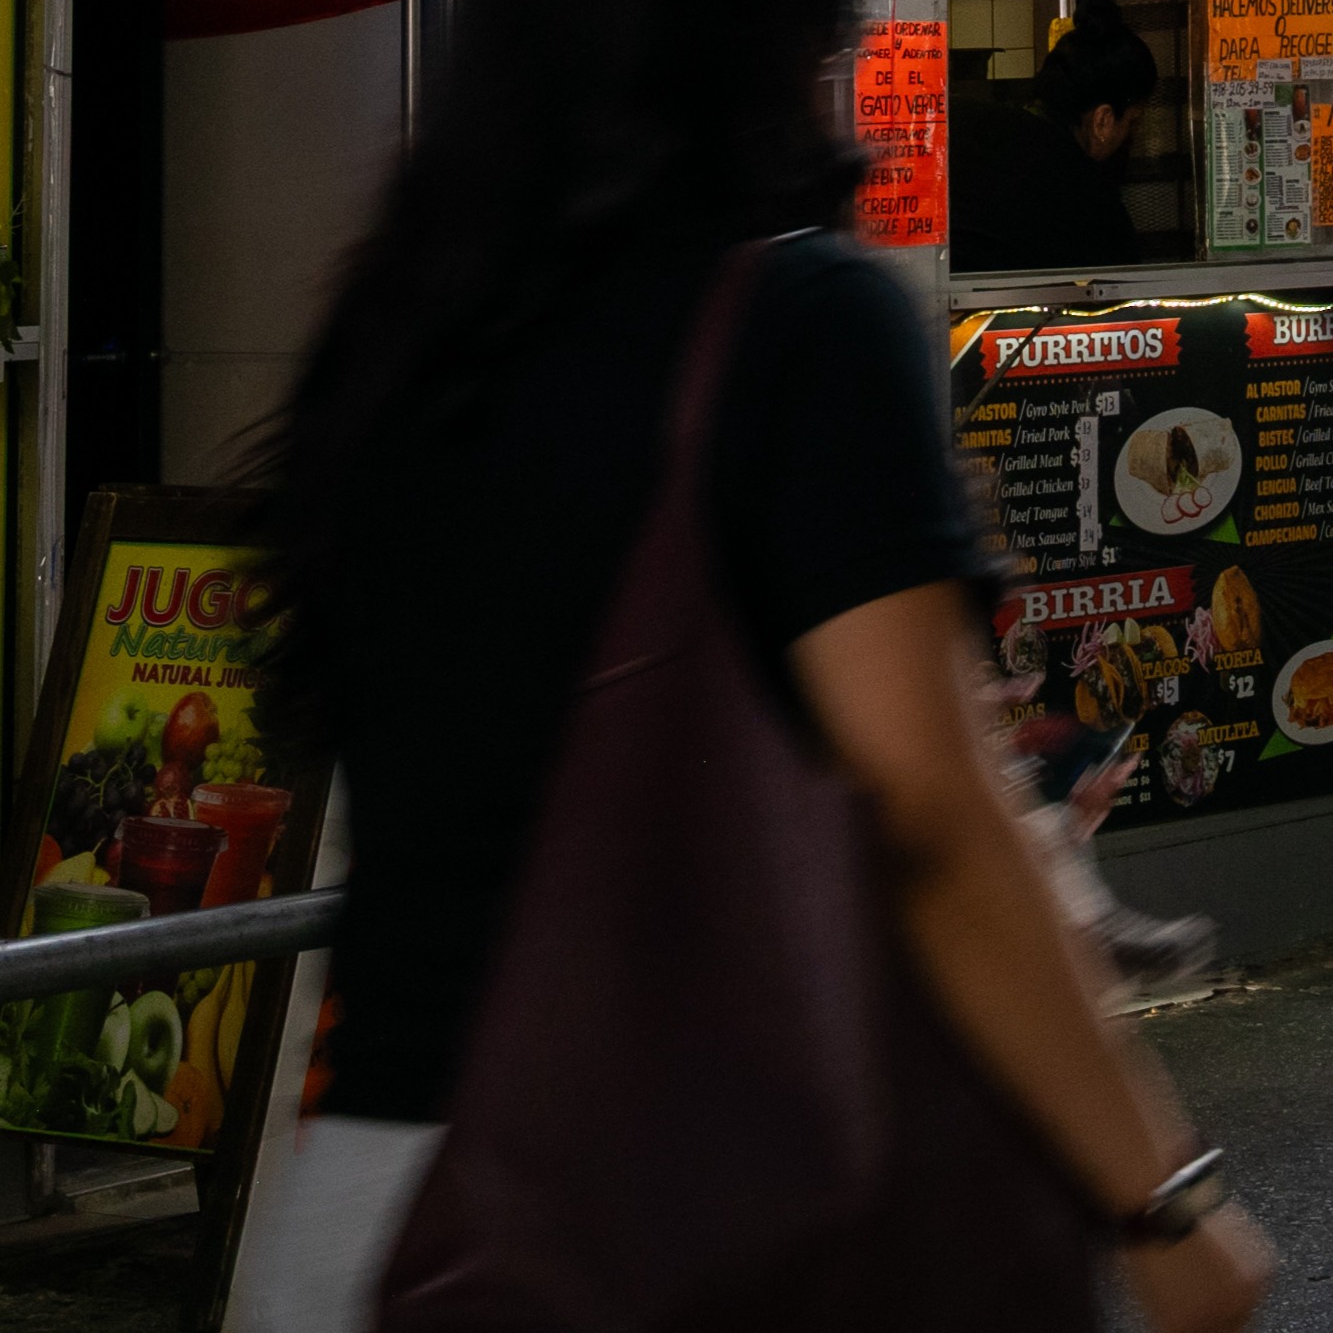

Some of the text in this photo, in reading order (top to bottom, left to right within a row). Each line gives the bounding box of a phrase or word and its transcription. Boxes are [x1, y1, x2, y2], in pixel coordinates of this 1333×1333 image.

[895, 22, 942, 36] ORDENAR
[908, 71, 924, 85] EL
[905, 94, 945, 115] VERDE
[995, 327, 1163, 369] BURRITOS
[1261, 379, 1301, 398] PASTOR
[1256, 404, 1306, 423] CARNITAS
[1259, 429, 1295, 448] BISTEC
[1256, 454, 1287, 472] POLLO
[1257, 477, 1297, 496] LENGUA
[1254, 501, 1300, 521] CHORIZO
[1245, 524, 1318, 547] CAMPECHANO
[106, 566, 276, 631] JUGO
[1021, 576, 1175, 624] BIRRIA
[1142, 656, 1191, 680] TACOS
[1214, 649, 1264, 671] TORTA
[132, 662, 258, 689] NATURAL JUIC
[1228, 674, 1255, 699] $12
[1198, 720, 1260, 746] MULITA
[1217, 749, 1236, 773] $7
